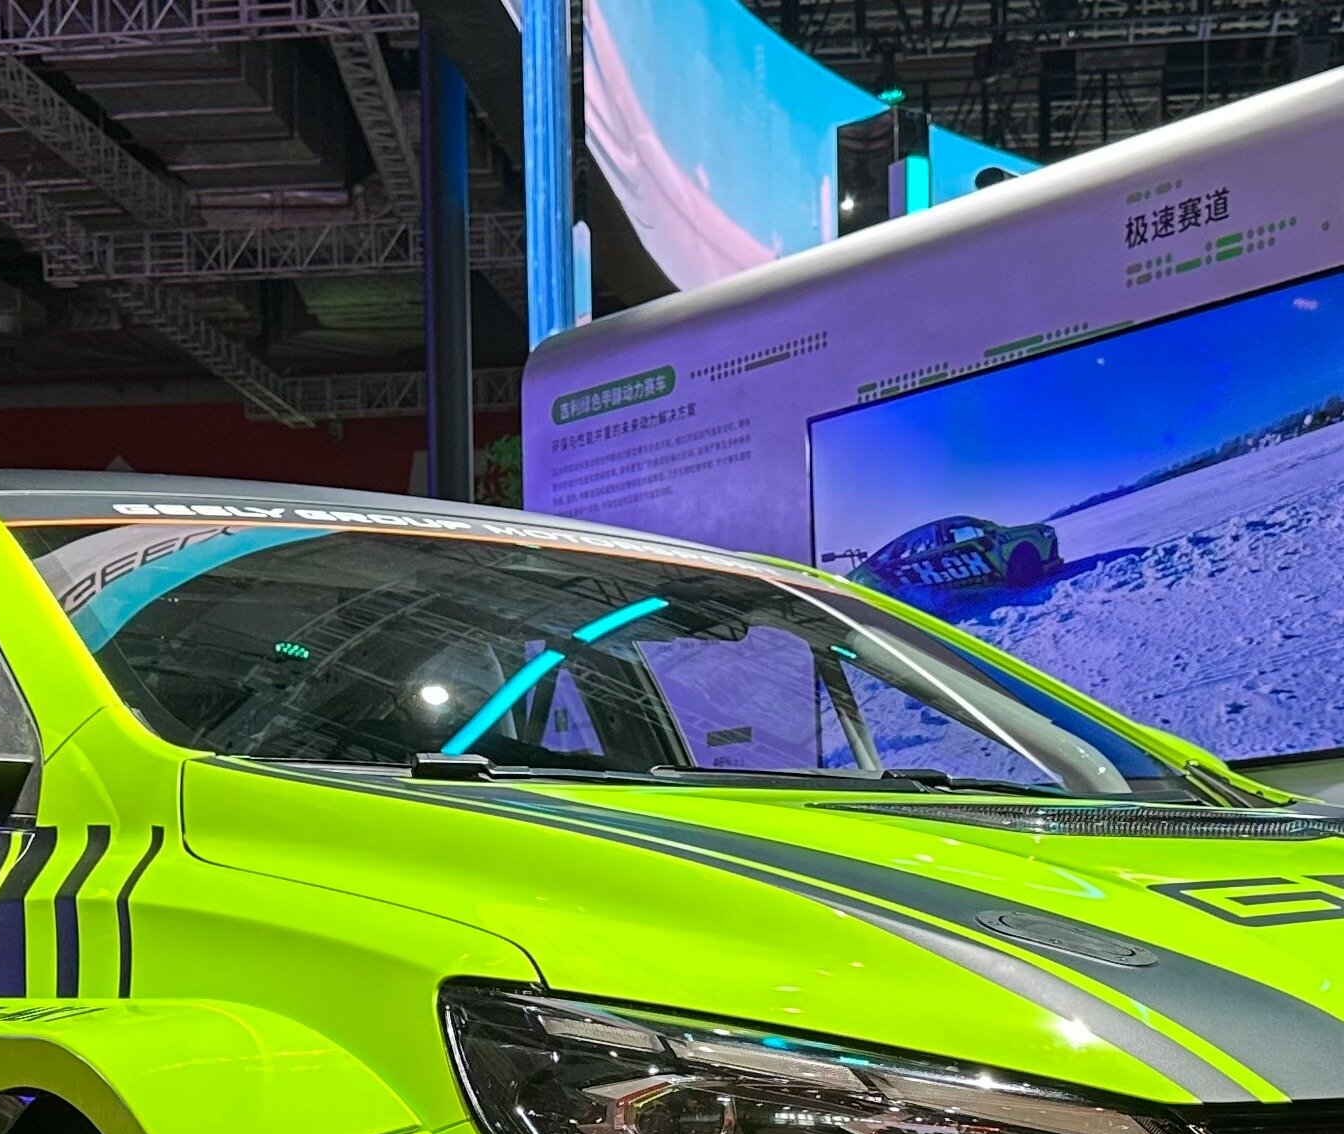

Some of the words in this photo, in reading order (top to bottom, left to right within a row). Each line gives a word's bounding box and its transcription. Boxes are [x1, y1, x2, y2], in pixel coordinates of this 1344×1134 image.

[1124, 186, 1230, 249] 极速赛道
[112, 503, 286, 519] GEELY
[294, 508, 472, 530] GROUP
